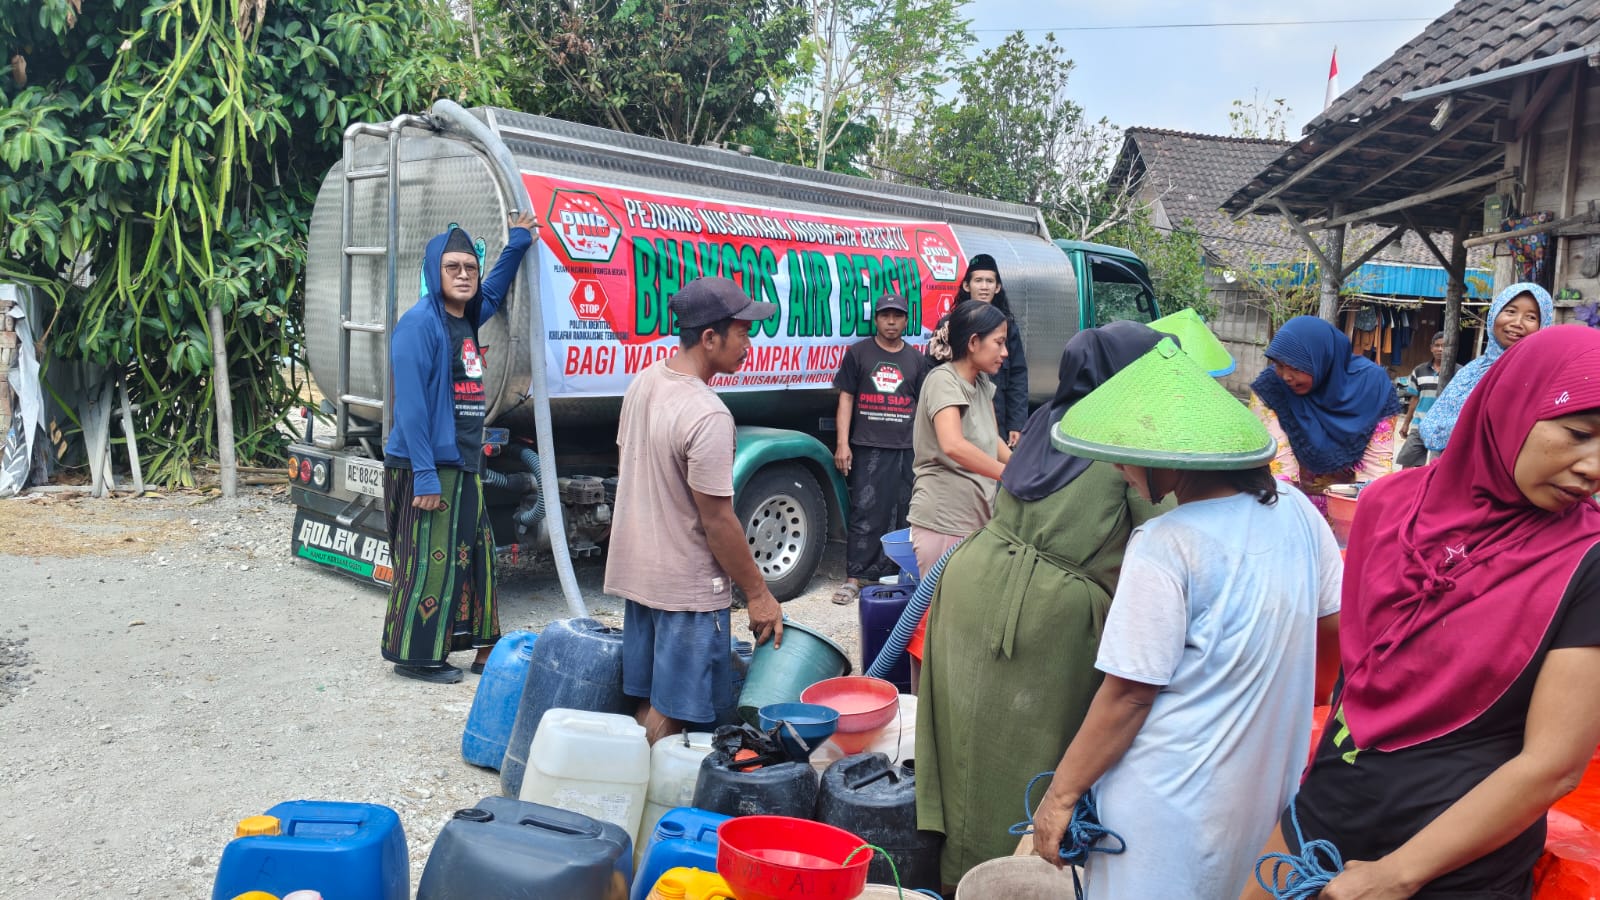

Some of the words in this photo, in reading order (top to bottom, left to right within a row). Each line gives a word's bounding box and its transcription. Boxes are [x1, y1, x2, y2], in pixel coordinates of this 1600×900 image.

[560, 210, 610, 238] PNIB
[622, 196, 701, 234] PEJUANG
[697, 208, 791, 241] NUSANTARA
[786, 219, 858, 247] INDONESIA
[858, 226, 909, 251] BERSATU
[786, 248, 833, 337] AIR
[579, 303, 600, 314] STOP
[564, 345, 617, 376] BAGI
[735, 345, 803, 374] AMPAK
[806, 345, 851, 372] MUSI
[454, 381, 480, 393] NIB
[708, 376, 739, 388] UANG
[742, 374, 803, 387] NUSANTARA
[805, 372, 835, 384] INDON
[347, 464, 357, 482] AE
[359, 466, 379, 487] 8842
[298, 518, 359, 557] GOLEK
